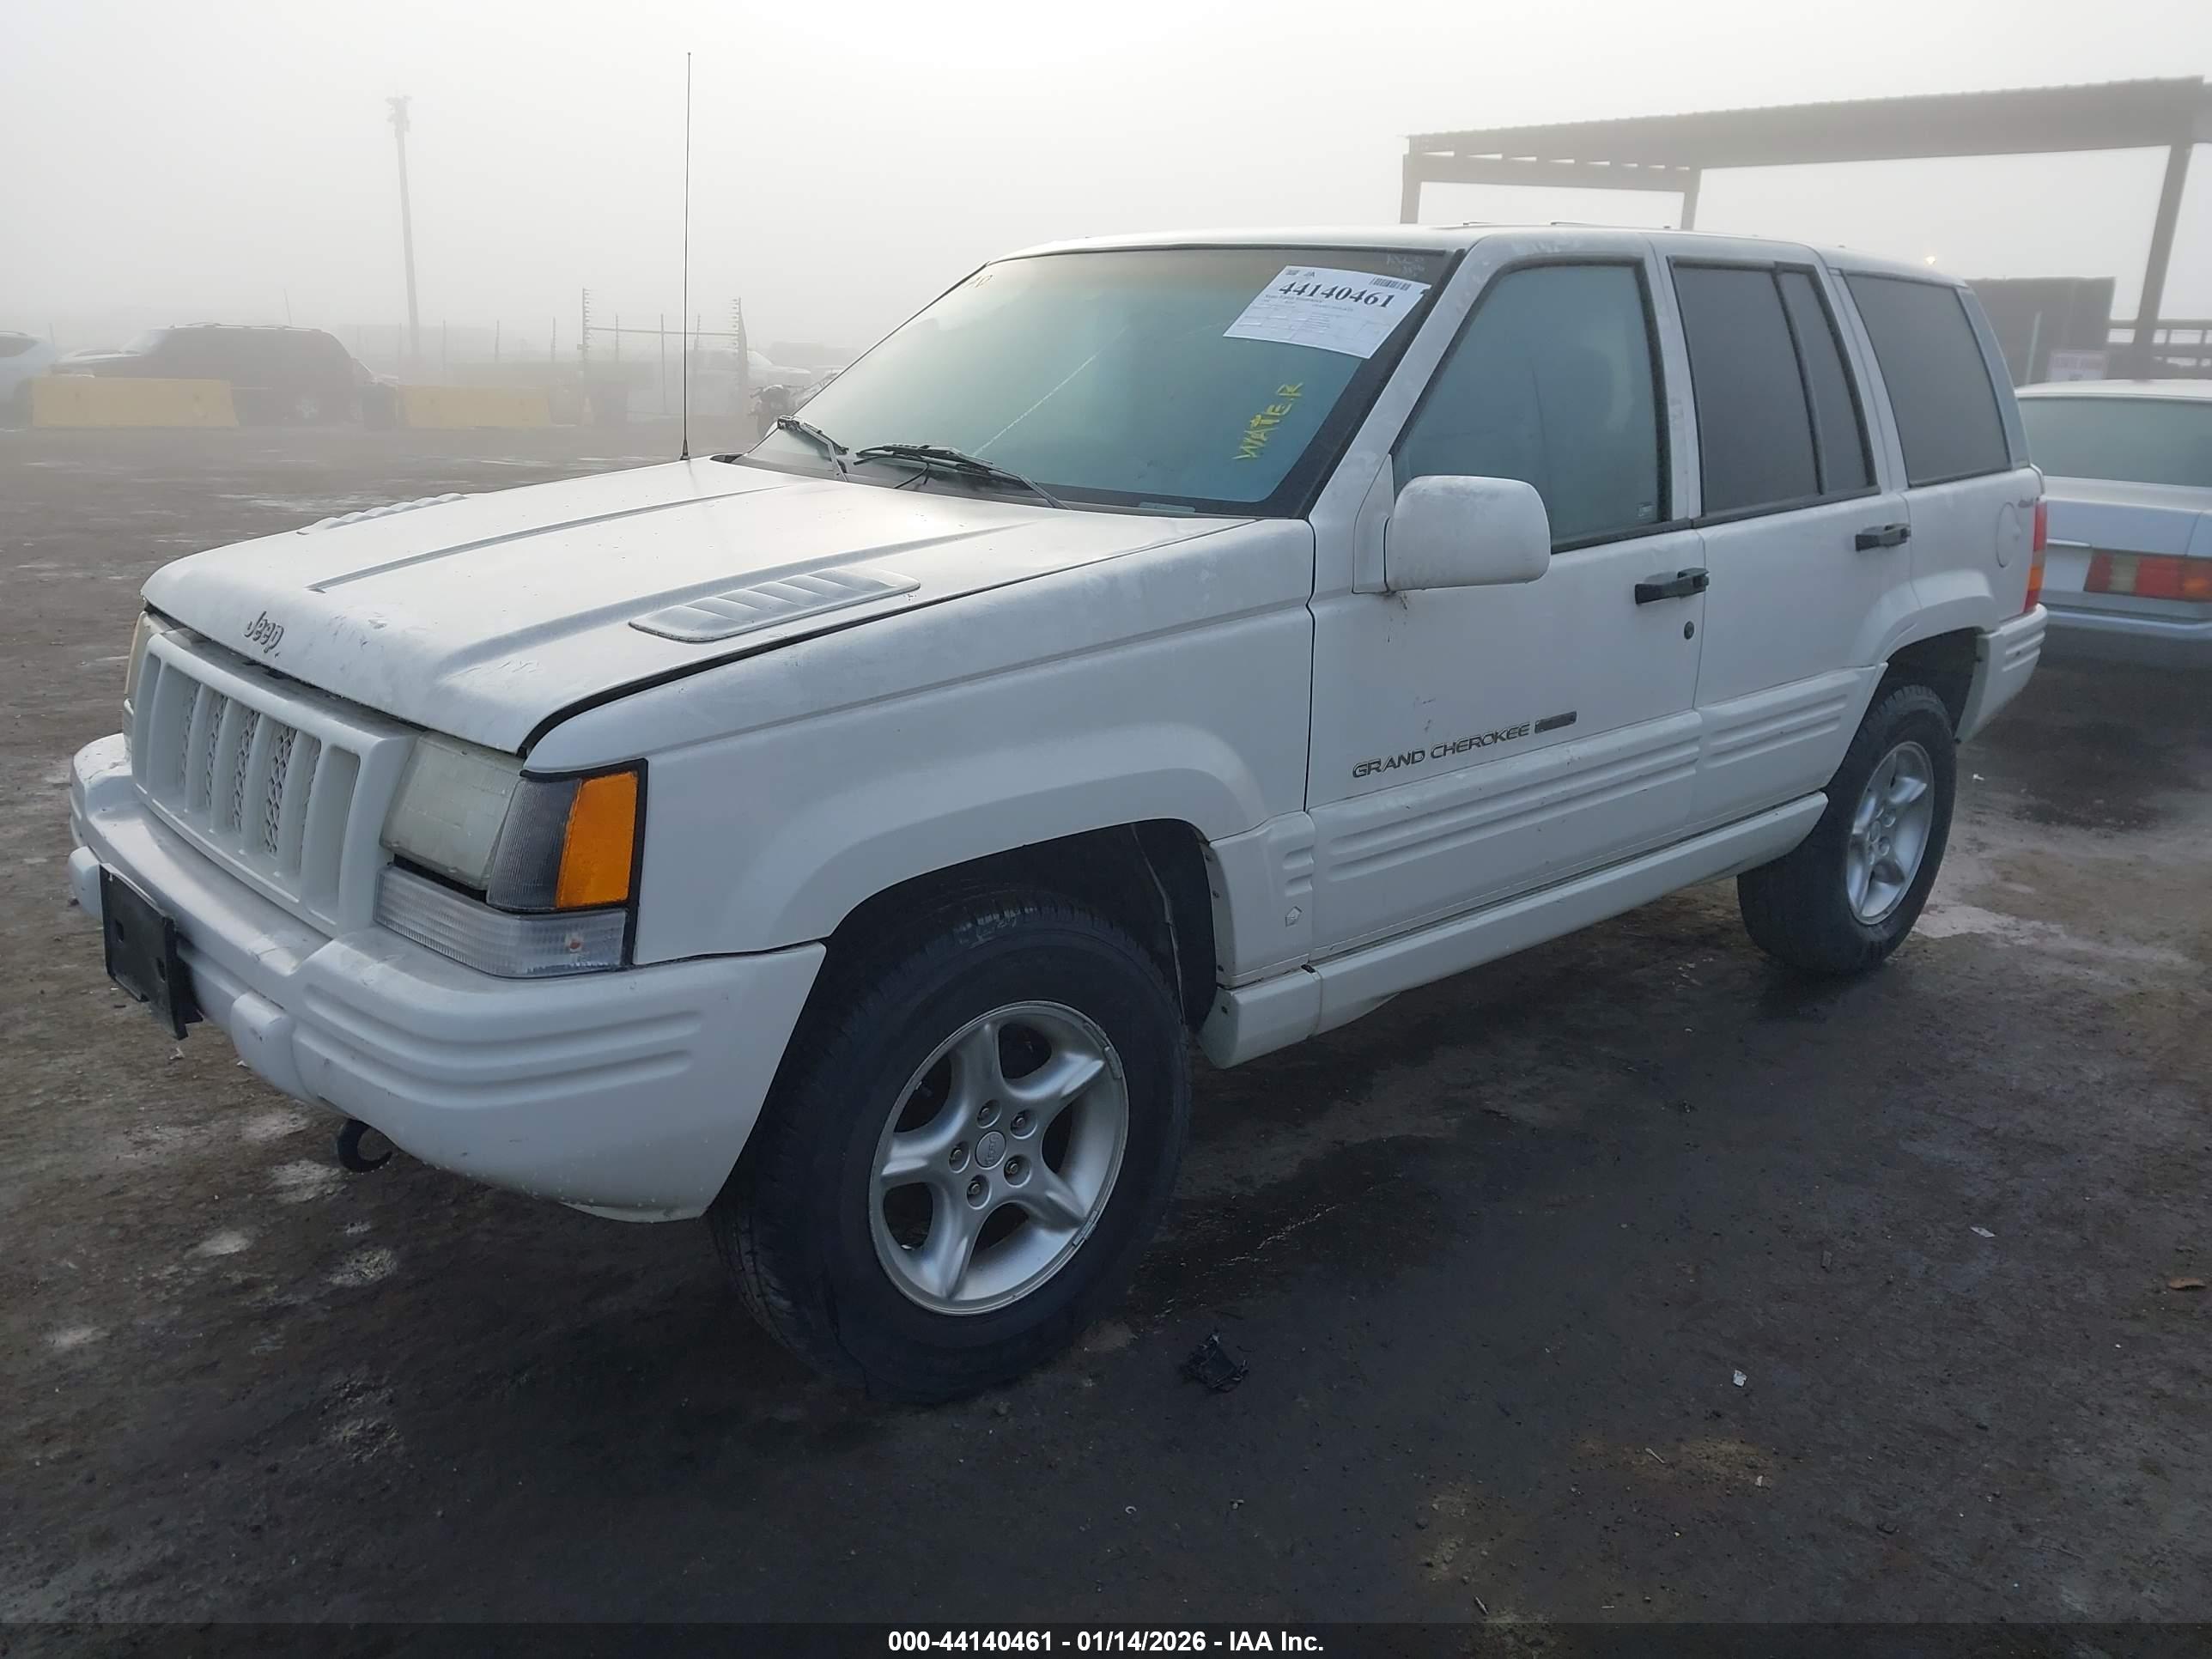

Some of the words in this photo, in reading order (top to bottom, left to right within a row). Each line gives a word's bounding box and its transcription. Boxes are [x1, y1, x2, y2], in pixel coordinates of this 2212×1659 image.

[1279, 281, 1395, 308] 44140461
[1231, 382, 1304, 459] WATER
[244, 611, 284, 653] Jeep
[1352, 750, 1425, 778] GRAND
[1430, 722, 1531, 760] CHEROKEE
